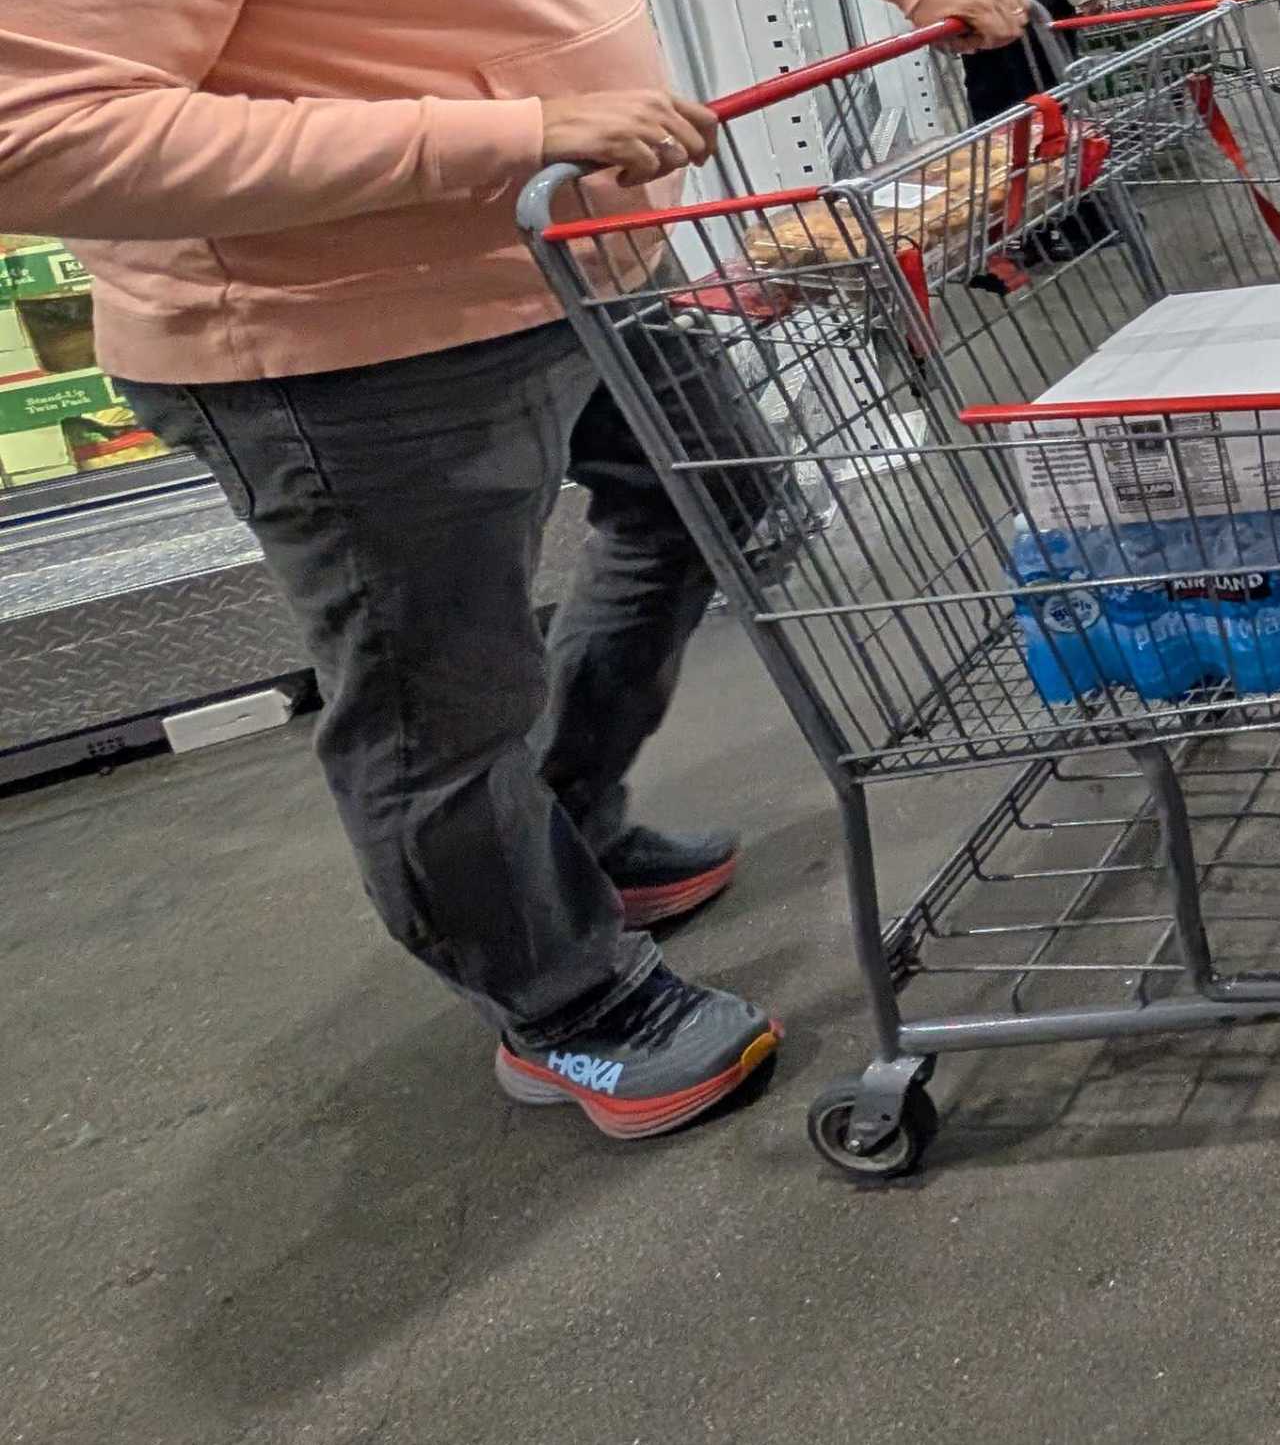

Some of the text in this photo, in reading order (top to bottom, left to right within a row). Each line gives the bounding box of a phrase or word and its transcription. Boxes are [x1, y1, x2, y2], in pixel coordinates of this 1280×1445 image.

[24, 395, 93, 414] Twin Pack
[25, 388, 87, 407] Stand-Up
[1173, 573, 1265, 592] KIRLAND
[548, 1050, 625, 1095] HOKA
